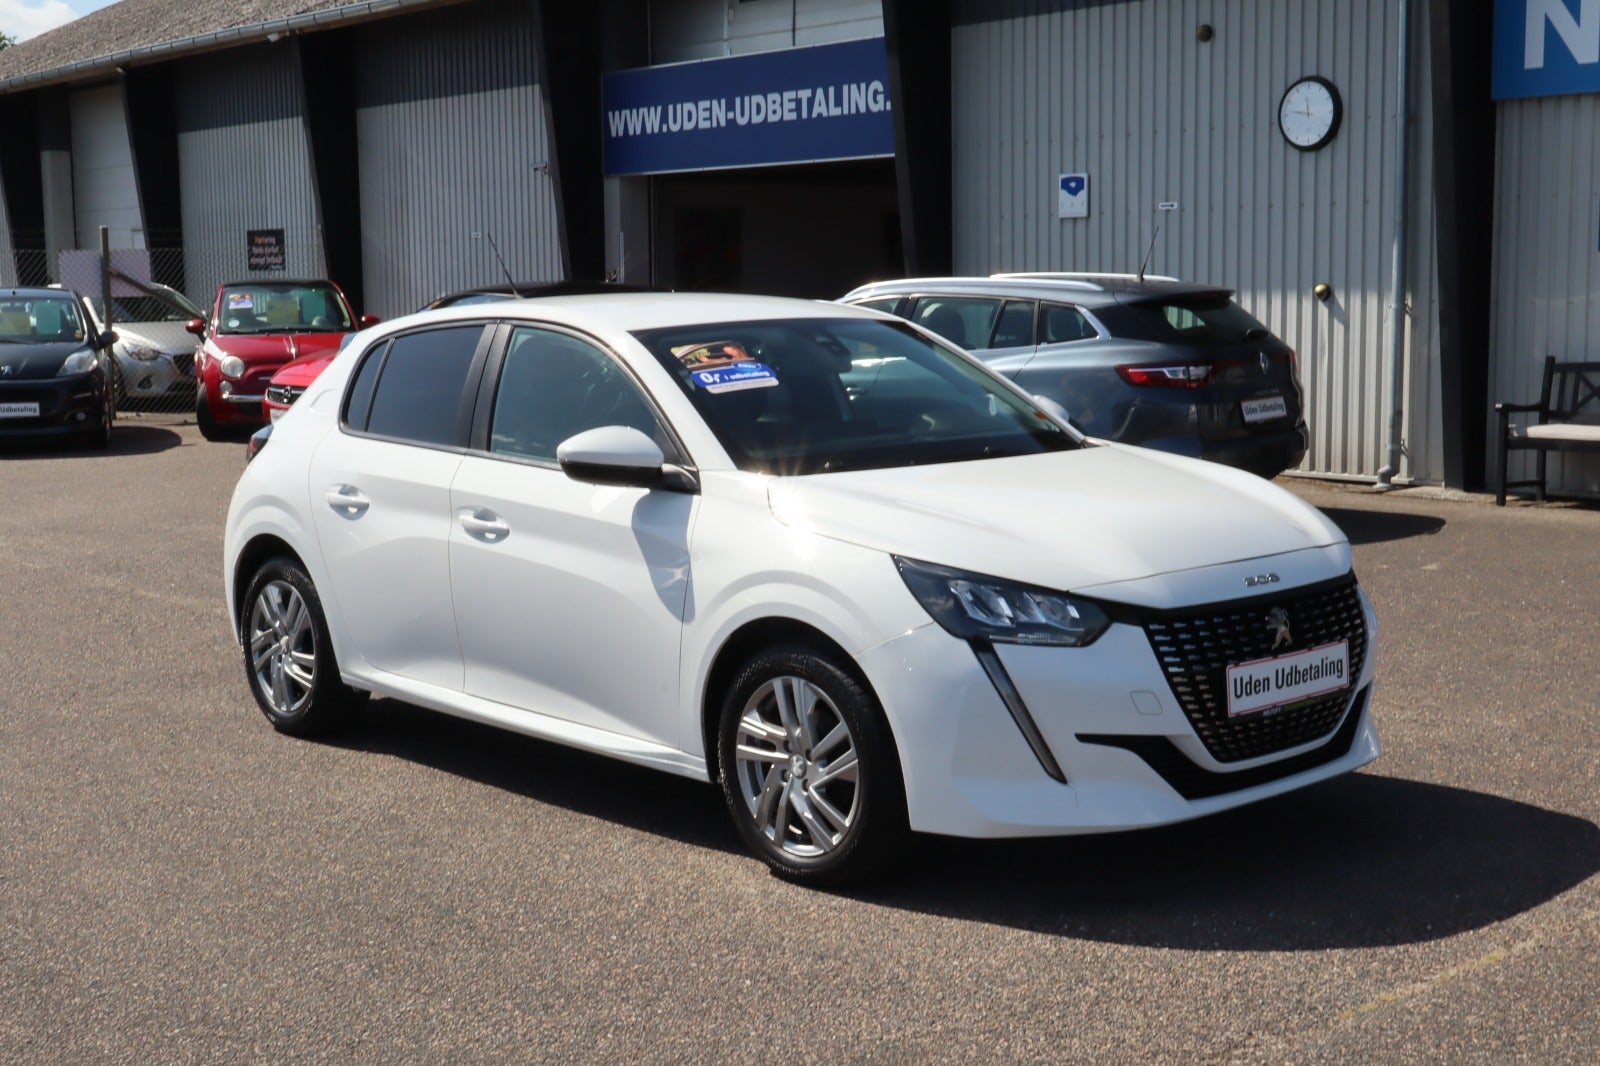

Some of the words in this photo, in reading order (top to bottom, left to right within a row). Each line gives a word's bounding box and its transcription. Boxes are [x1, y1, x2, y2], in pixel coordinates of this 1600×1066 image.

[1524, 0, 1599, 69] N
[608, 80, 891, 137] WWW.UDEN-UDBETALING.
[1244, 572, 1280, 587] 208
[1233, 674, 1270, 699] Uden
[1275, 656, 1343, 690] Udbetaling
